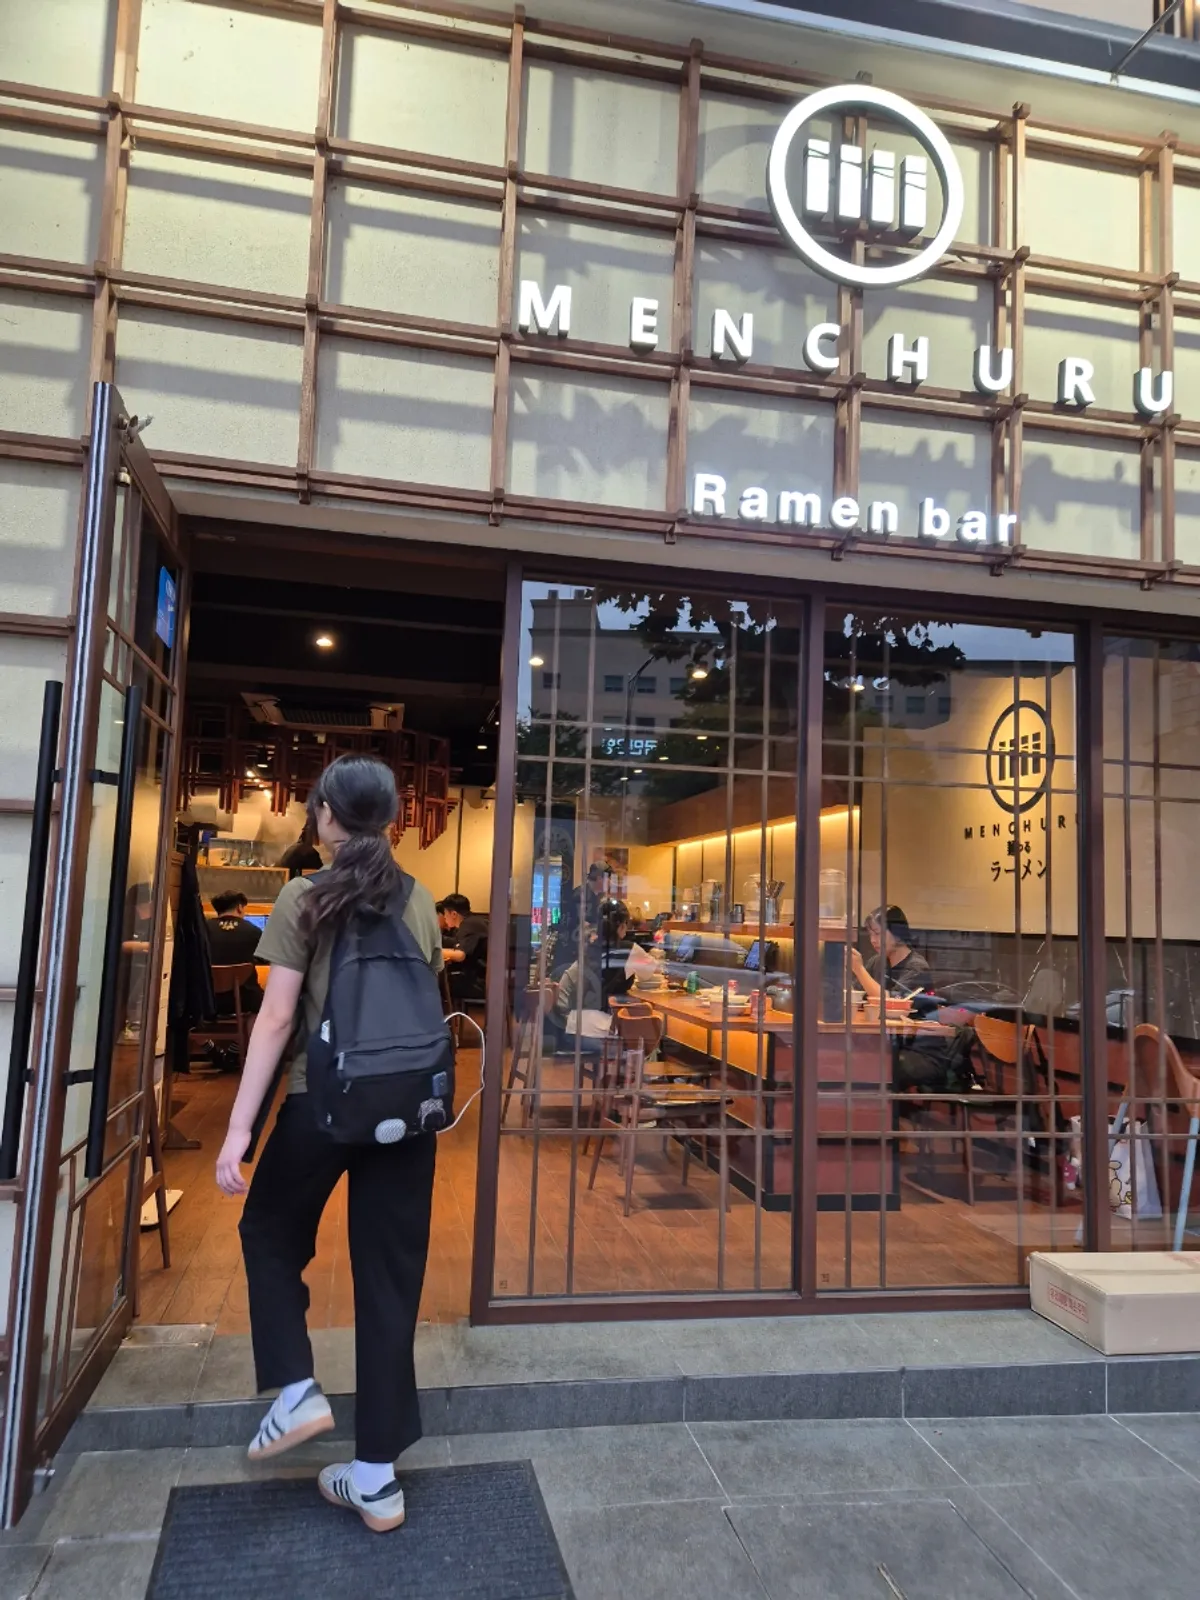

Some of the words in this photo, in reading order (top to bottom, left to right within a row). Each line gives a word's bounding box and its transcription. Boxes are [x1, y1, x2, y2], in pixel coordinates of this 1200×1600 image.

[518, 280, 1173, 414] MENCHURU
[692, 473, 899, 534] Ramen
[920, 498, 1017, 542] bar
[964, 814, 1079, 840] MENCHUR
[990, 859, 1047, 882] ラーメン
